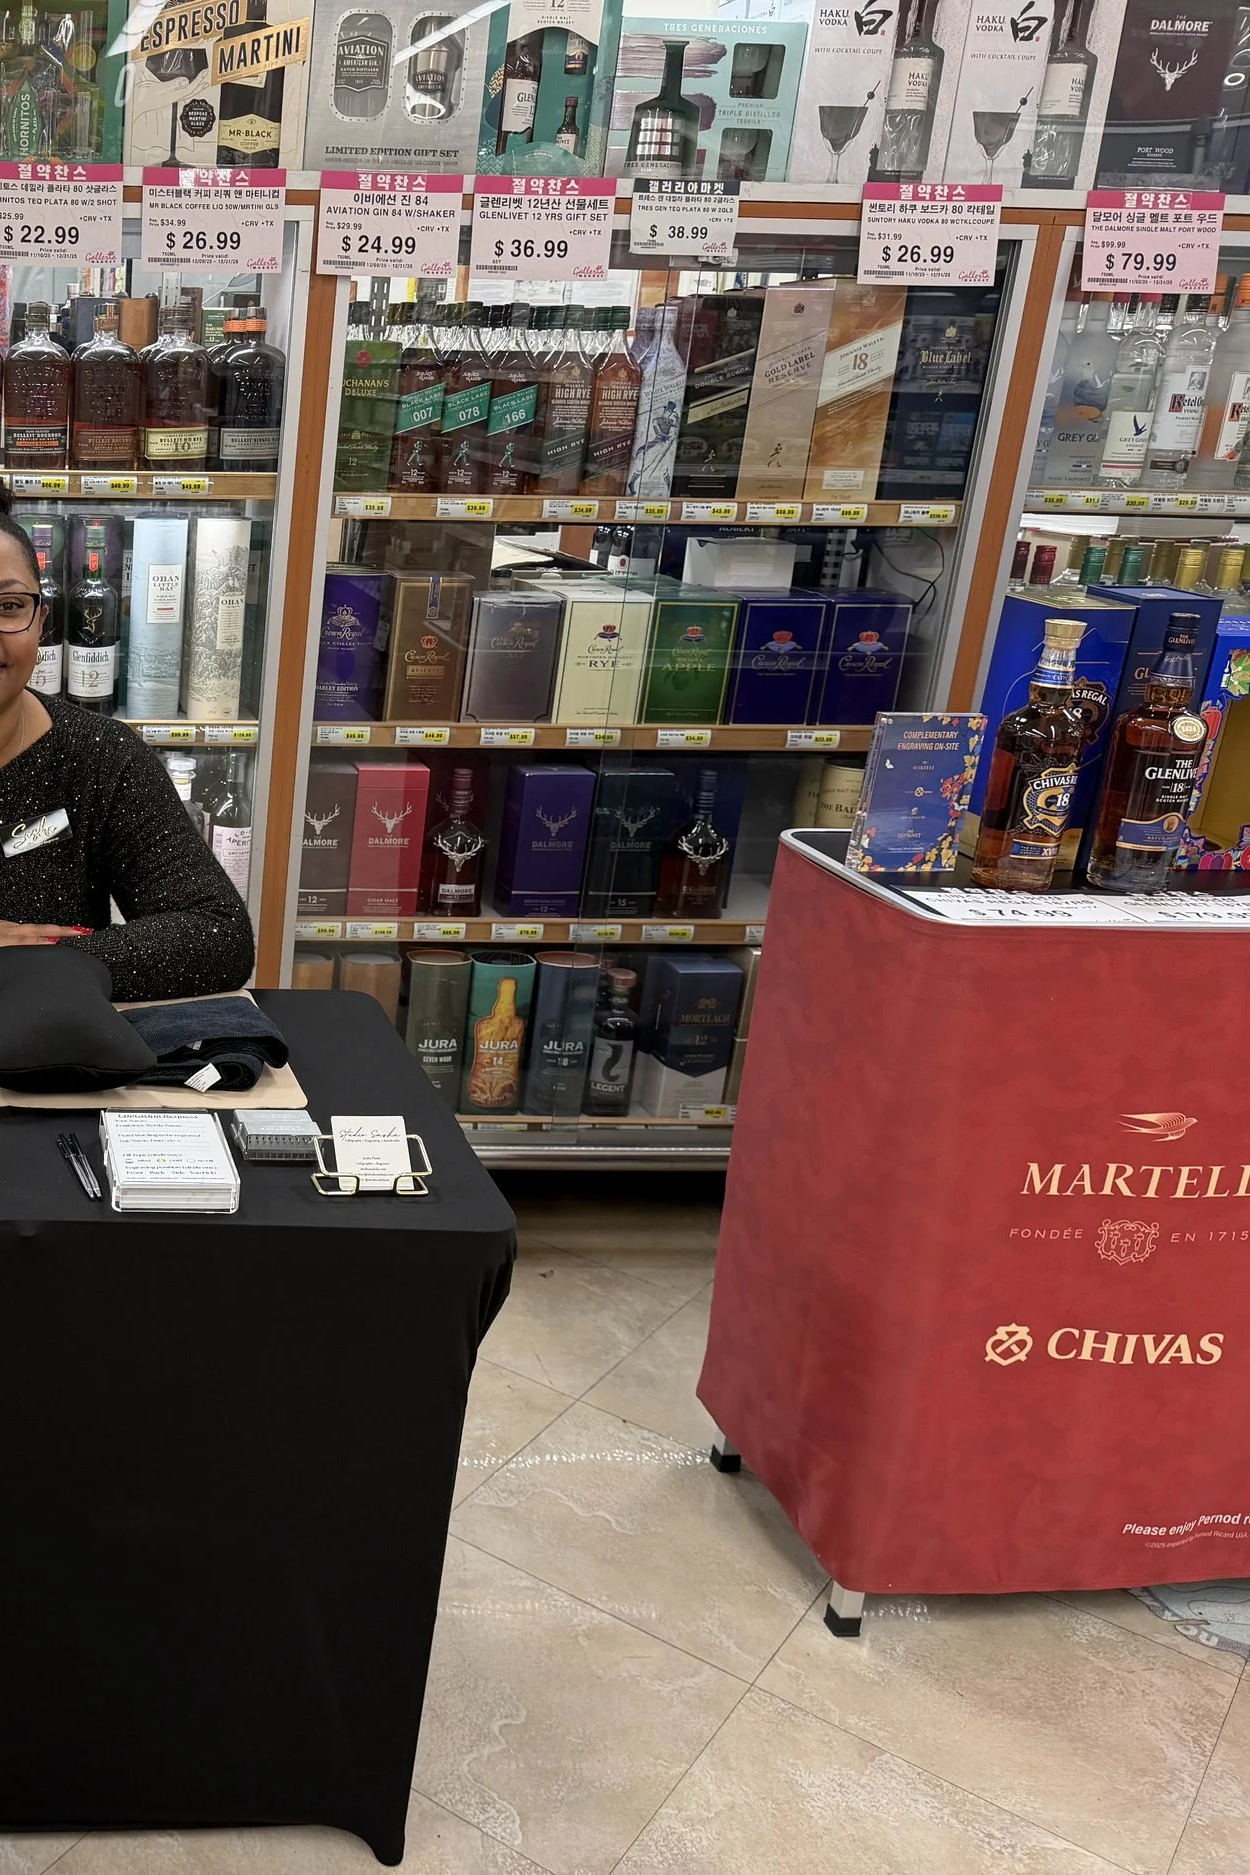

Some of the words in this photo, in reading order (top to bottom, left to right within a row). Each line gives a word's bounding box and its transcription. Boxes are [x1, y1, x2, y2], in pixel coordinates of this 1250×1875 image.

[819, 9, 848, 19] HAKU
[664, 23, 686, 31] TRES
[691, 24, 767, 34] GENERACIONES
[819, 18, 848, 27] VODKA
[1150, 19, 1210, 32] DALMORE
[219, 26, 301, 74] MARTINI
[338, 43, 384, 56] AVIATION
[325, 146, 368, 155] LIMITED
[370, 147, 411, 156] EDITION
[18, 164, 86, 180] 절약찬스
[358, 174, 426, 191] 절약찬스
[353, 193, 397, 205] 이비에션
[401, 194, 411, 206] 진
[415, 196, 428, 205] 84
[480, 196, 522, 208] 글렌리벳
[527, 198, 561, 209] 12년산
[565, 198, 609, 210] 선물세트
[1125, 193, 1189, 208] 절약찬스
[326, 207, 369, 216] AVIATION
[405, 209, 455, 218] W/SHAKER
[479, 212, 528, 220] GLENLIVET
[566, 213, 586, 221] GIFT
[20, 225, 79, 244] 22.99
[668, 226, 708, 239] 38.99
[182, 231, 241, 250] 26.99
[358, 235, 416, 254] 24.99
[511, 239, 568, 258] 36.99
[898, 245, 954, 264] 26.99
[1122, 253, 1176, 271] 79.99
[852, 353, 868, 371] 18
[555, 388, 574, 399] HIGH
[575, 388, 591, 399] RYE
[413, 407, 433, 422] 007
[459, 406, 480, 422] 078
[505, 409, 526, 424] 166
[589, 660, 620, 668] RYE
[903, 730, 959, 740] COMPLEMENTARY
[897, 742, 936, 751] ENGRAVING
[938, 741, 959, 751] ON-SITE
[1176, 759, 1193, 769] THE
[1033, 776, 1071, 791] CHIVAS
[1172, 781, 1184, 793] 18
[1056, 793, 1070, 807] 18
[479, 1040, 519, 1050] JURA
[1009, 1228, 1083, 1240] FONDÉE
[1171, 1232, 1196, 1243] EN
[1209, 1230, 1250, 1242] 1715
[1047, 1327, 1224, 1365] CHIVAS
[1122, 1523, 1166, 1536] Please
[1169, 1519, 1196, 1535] enjoy
[1198, 1513, 1241, 1527] Pernod
